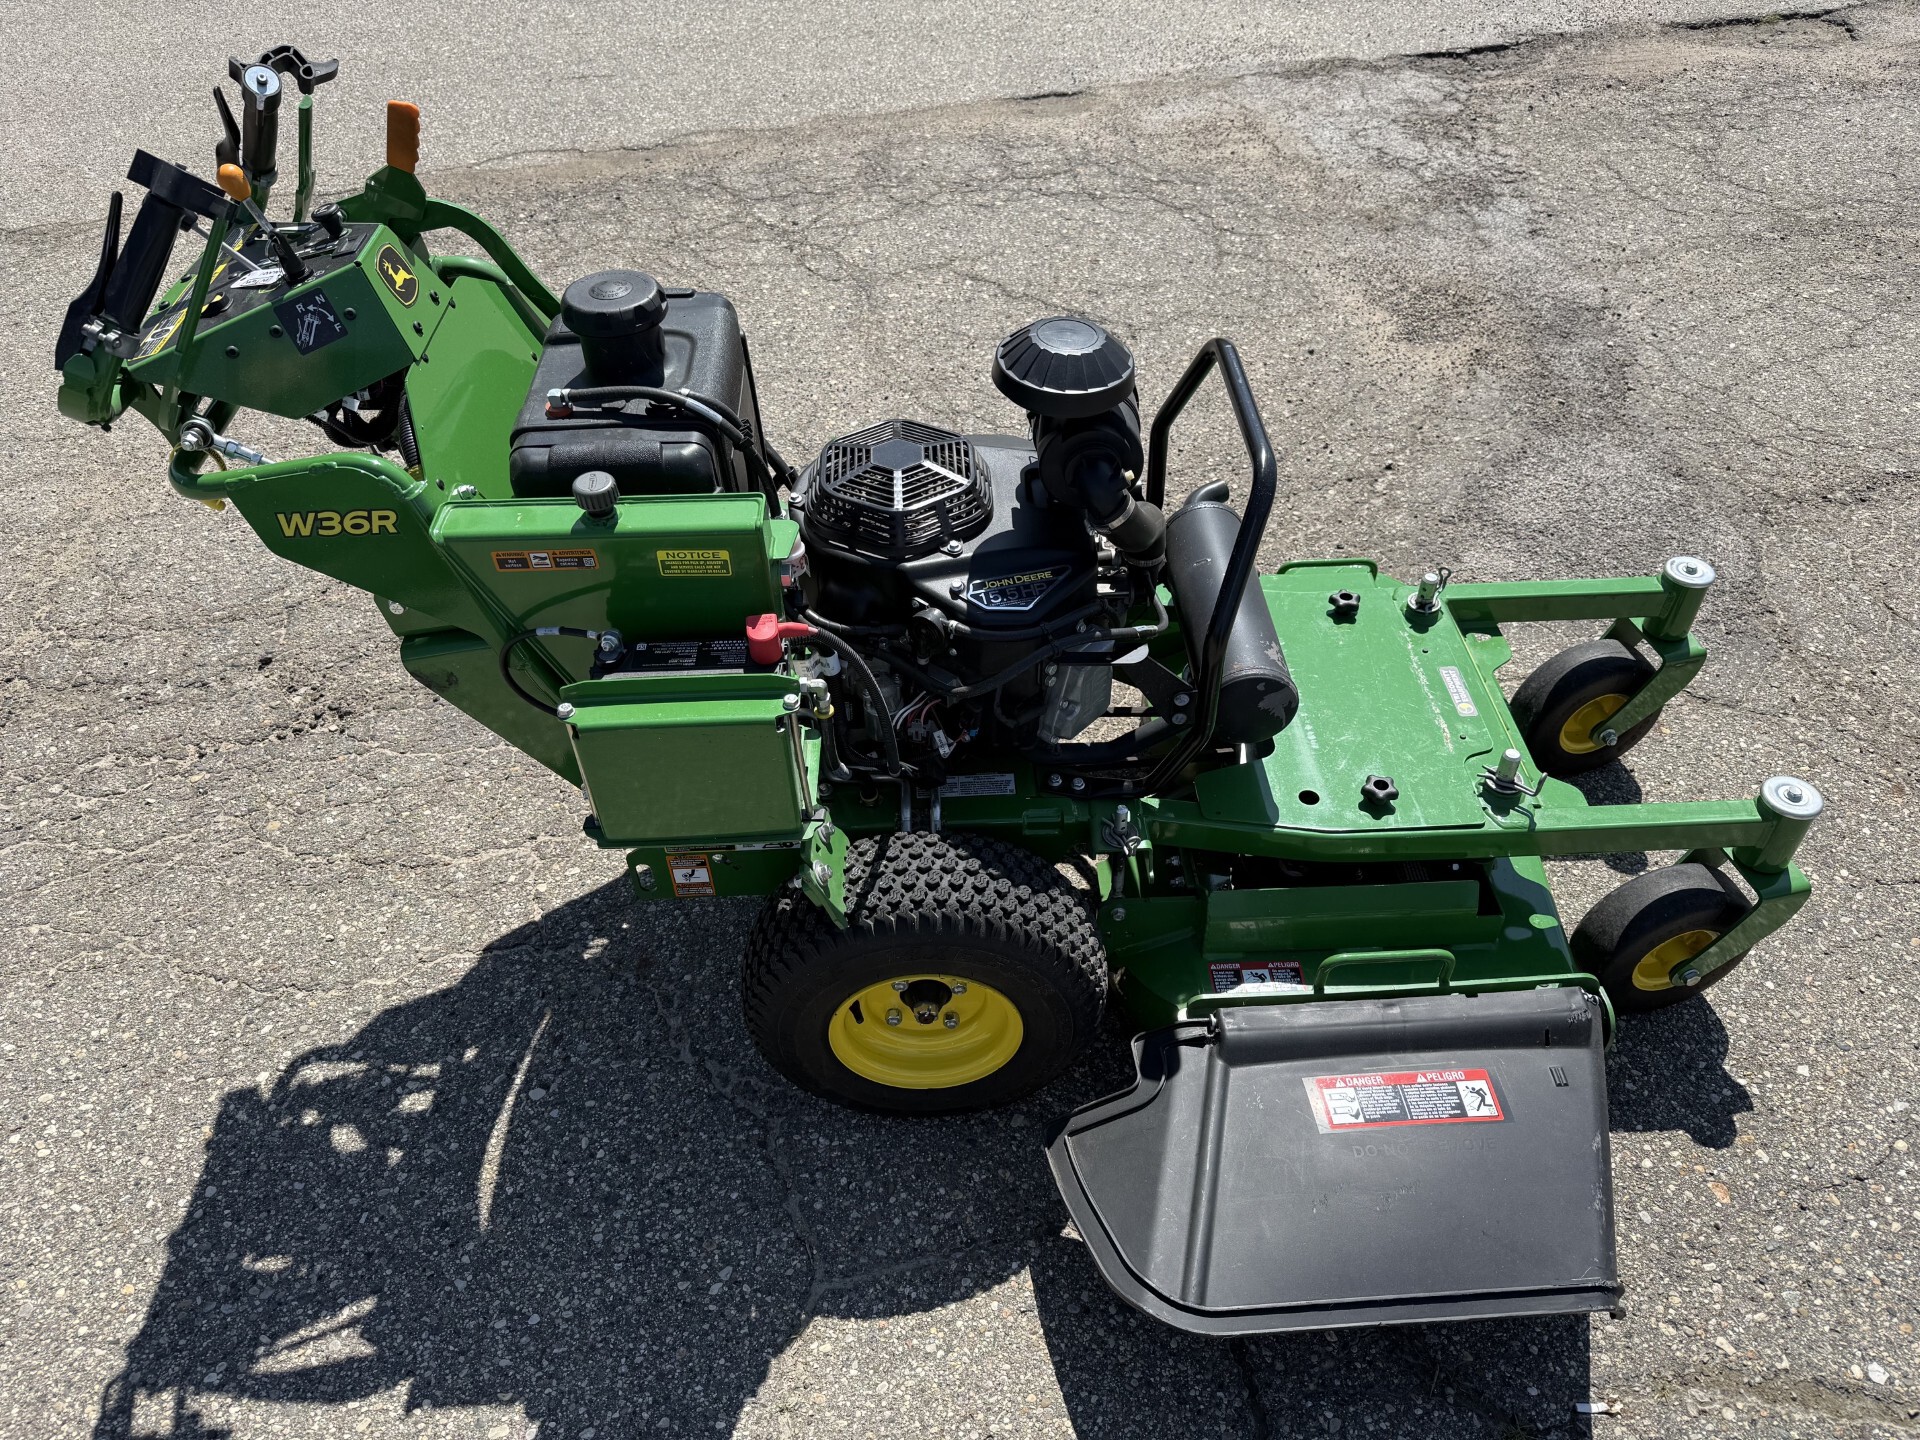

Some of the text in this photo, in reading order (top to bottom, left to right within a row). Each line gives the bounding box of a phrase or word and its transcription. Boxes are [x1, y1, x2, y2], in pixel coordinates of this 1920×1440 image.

[315, 294, 325, 304] N
[295, 302, 305, 313] R
[334, 322, 342, 332] F
[276, 509, 398, 537] W36R
[983, 571, 1053, 590] JOHN DEERE
[1442, 670, 1462, 704] TRI COUNTY
[1346, 1076, 1384, 1086] DANGER
[1426, 1071, 1465, 1081] PELIGRO
[1352, 1144, 1377, 1159] DO
[1423, 1138, 1497, 1153] REOVE
